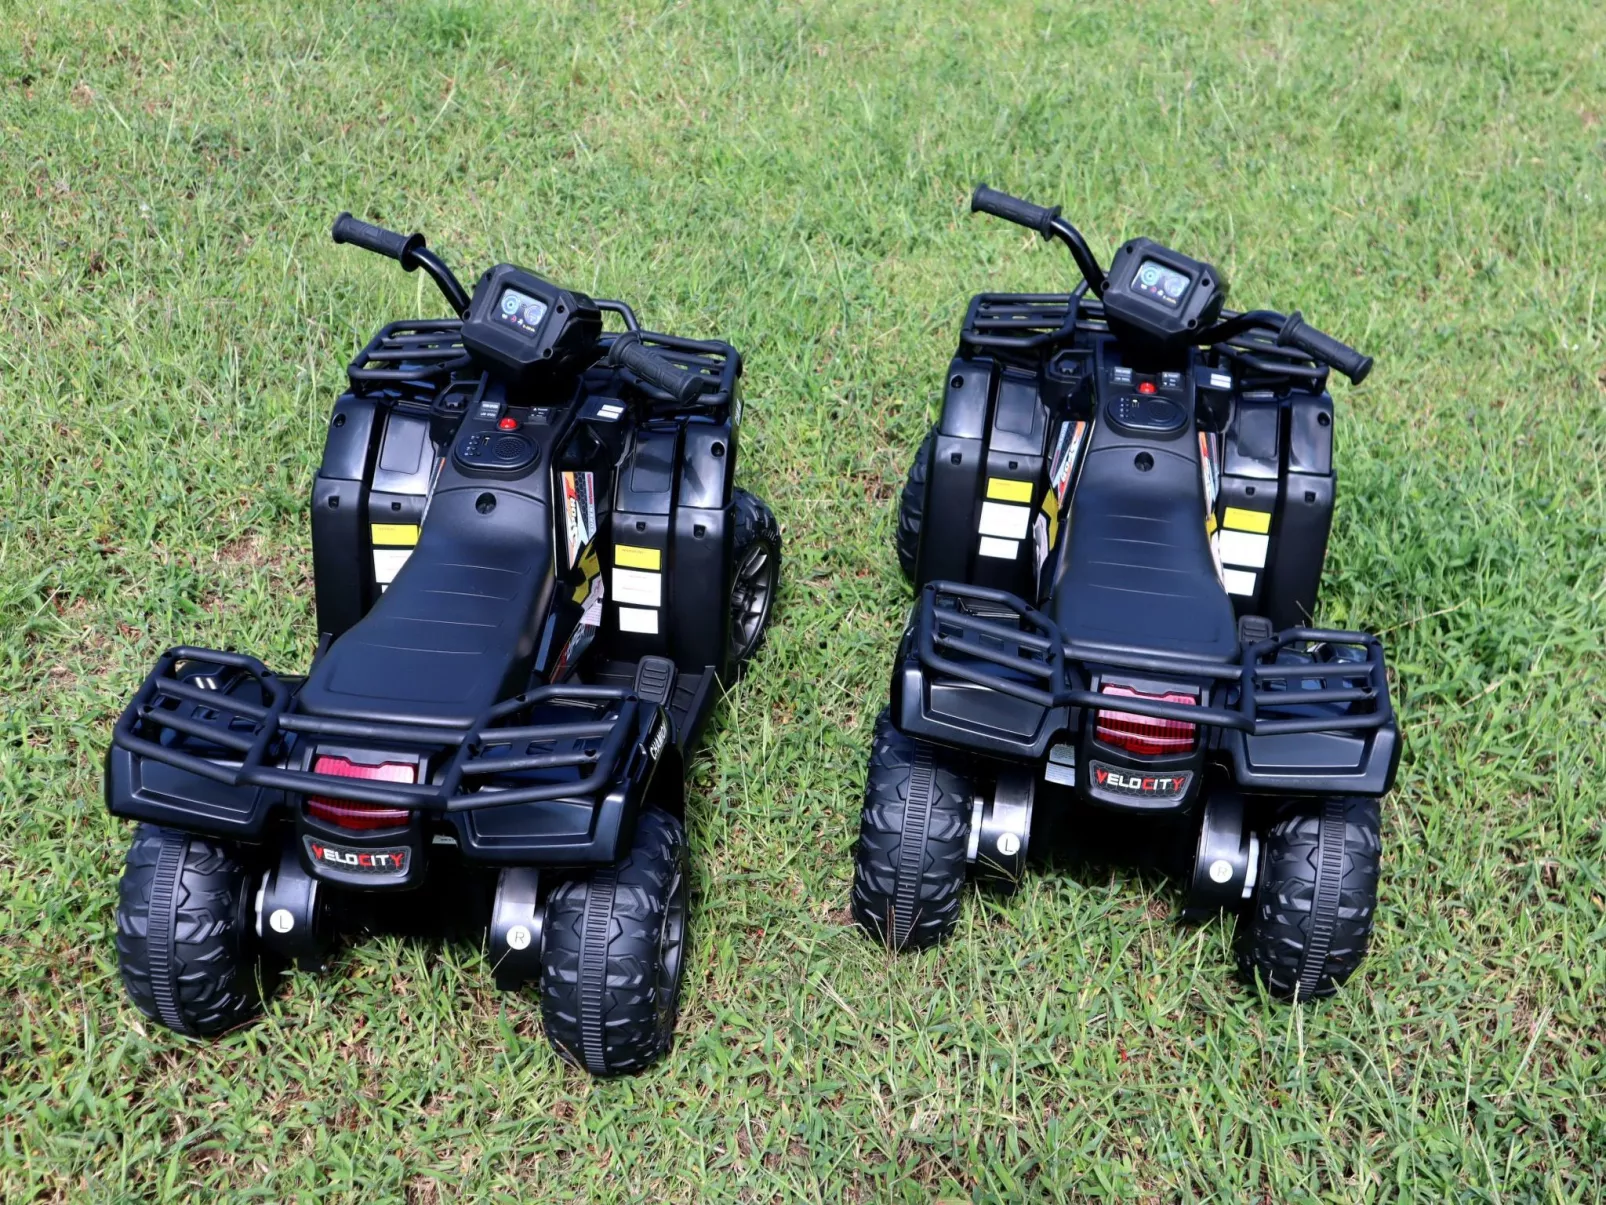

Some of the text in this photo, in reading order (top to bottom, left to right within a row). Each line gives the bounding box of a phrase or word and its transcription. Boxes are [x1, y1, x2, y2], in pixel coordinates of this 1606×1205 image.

[1096, 768, 1185, 791] VELOCITY
[1004, 838, 1014, 852] L
[311, 843, 404, 867] VELOCITY
[279, 915, 289, 929] L
[514, 931, 525, 944] R
